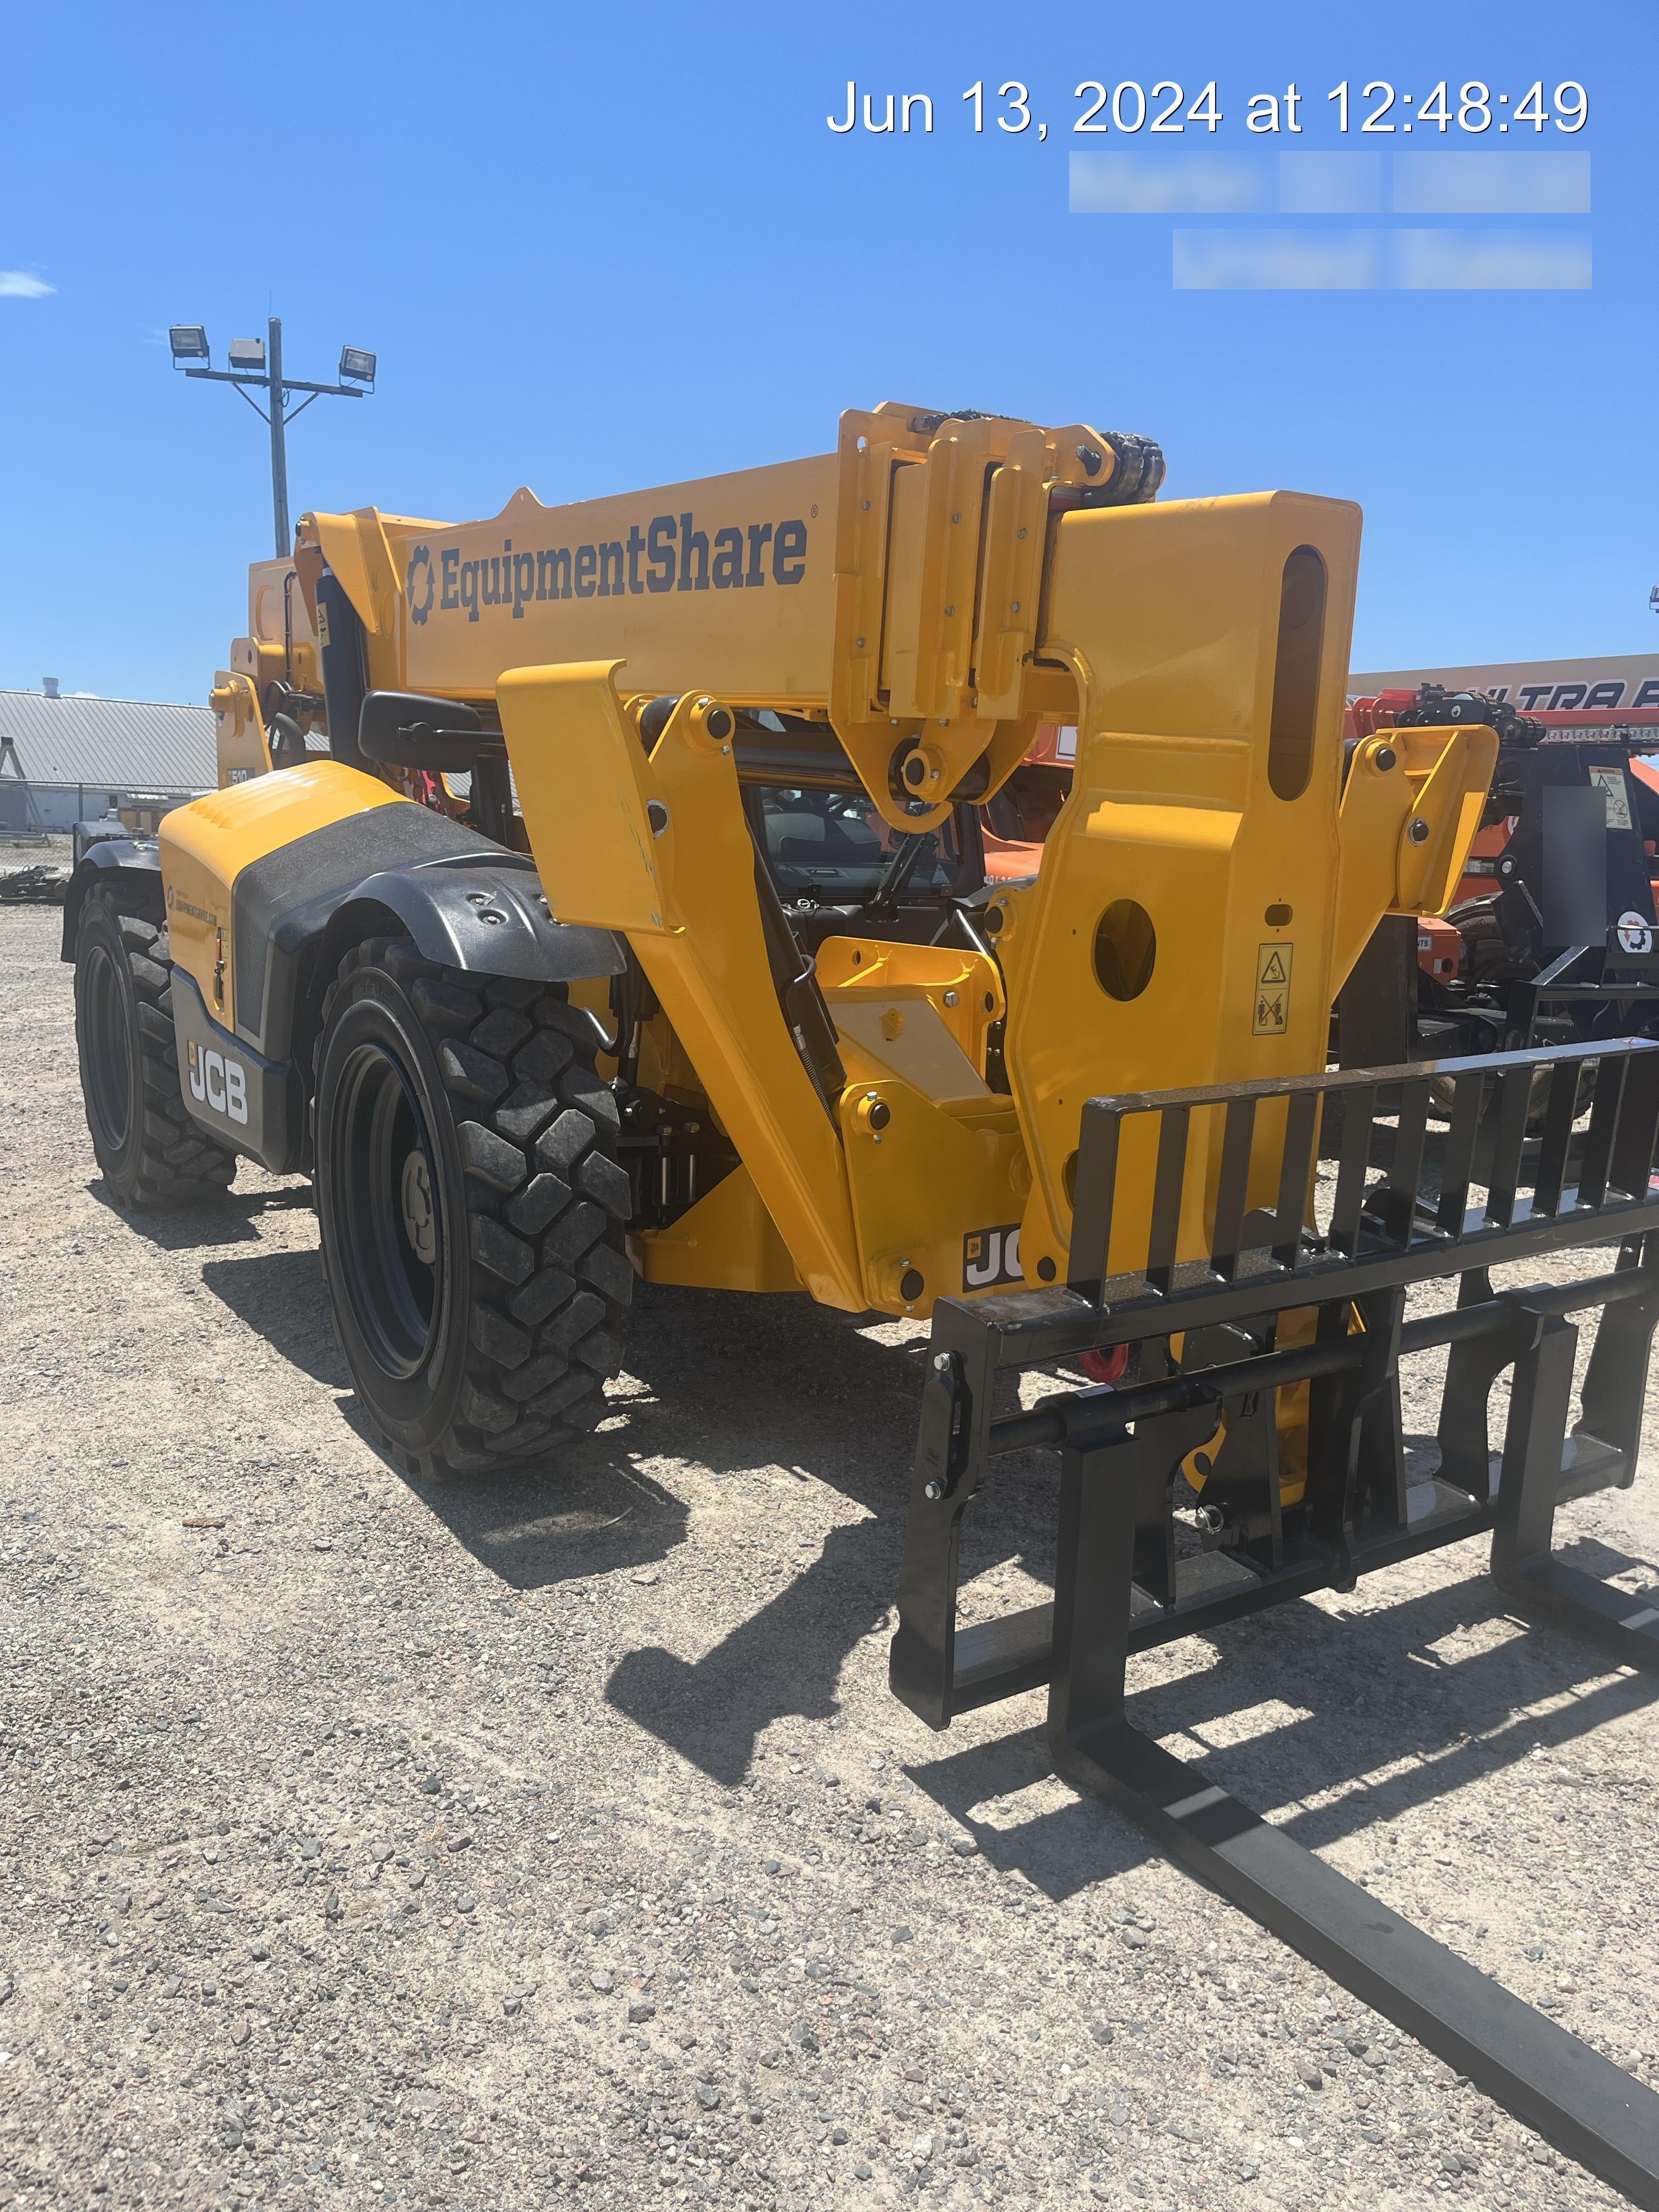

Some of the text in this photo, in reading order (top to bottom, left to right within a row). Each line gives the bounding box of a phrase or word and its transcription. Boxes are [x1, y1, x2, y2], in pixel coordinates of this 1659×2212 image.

[441, 512, 807, 622] EquipmentShare
[1466, 681, 1627, 711] TRA
[190, 1045, 248, 1125] JCB
[967, 1229, 1024, 1285] JC
